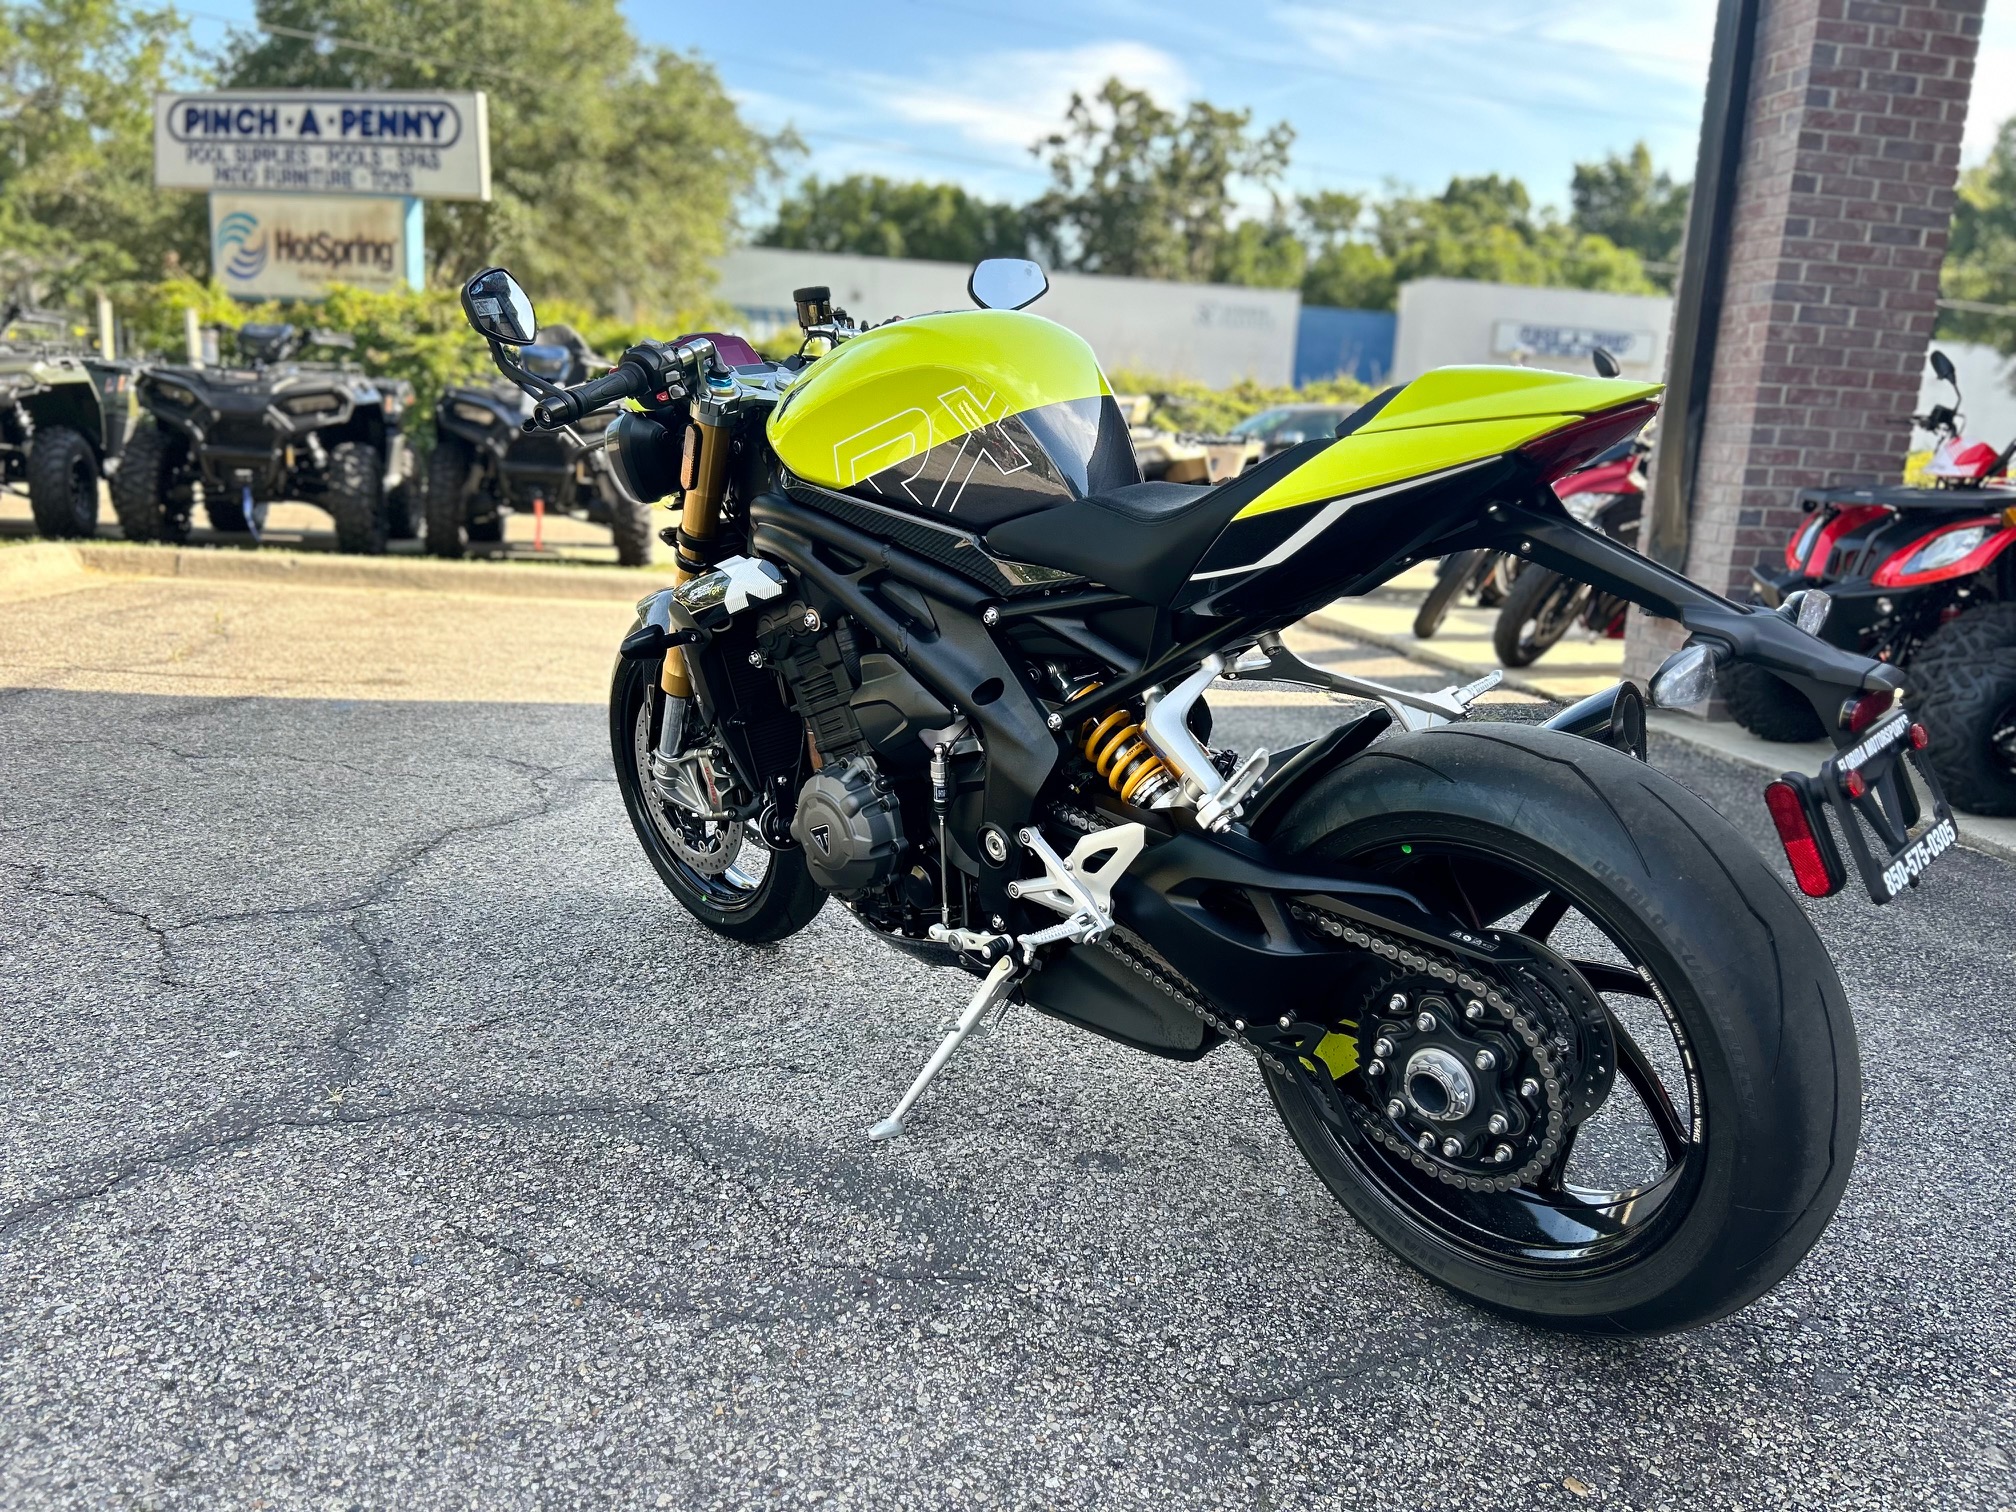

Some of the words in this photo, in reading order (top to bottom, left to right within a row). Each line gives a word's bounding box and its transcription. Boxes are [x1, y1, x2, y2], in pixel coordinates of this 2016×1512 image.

[184, 107, 279, 135] PINCH
[299, 107, 321, 136] A
[340, 108, 447, 140] PENNY
[186, 146, 226, 165] POOL
[234, 146, 310, 166] SUPPLIES
[326, 148, 382, 168] POOLS
[397, 150, 441, 171] SPAS
[264, 166, 354, 188] FURNITURE
[371, 169, 414, 191] TOYS
[275, 228, 394, 272] HotSpring
[1882, 818, 1956, 896] 850-575-0305
[1649, 981, 1674, 1020] TUBELESS
